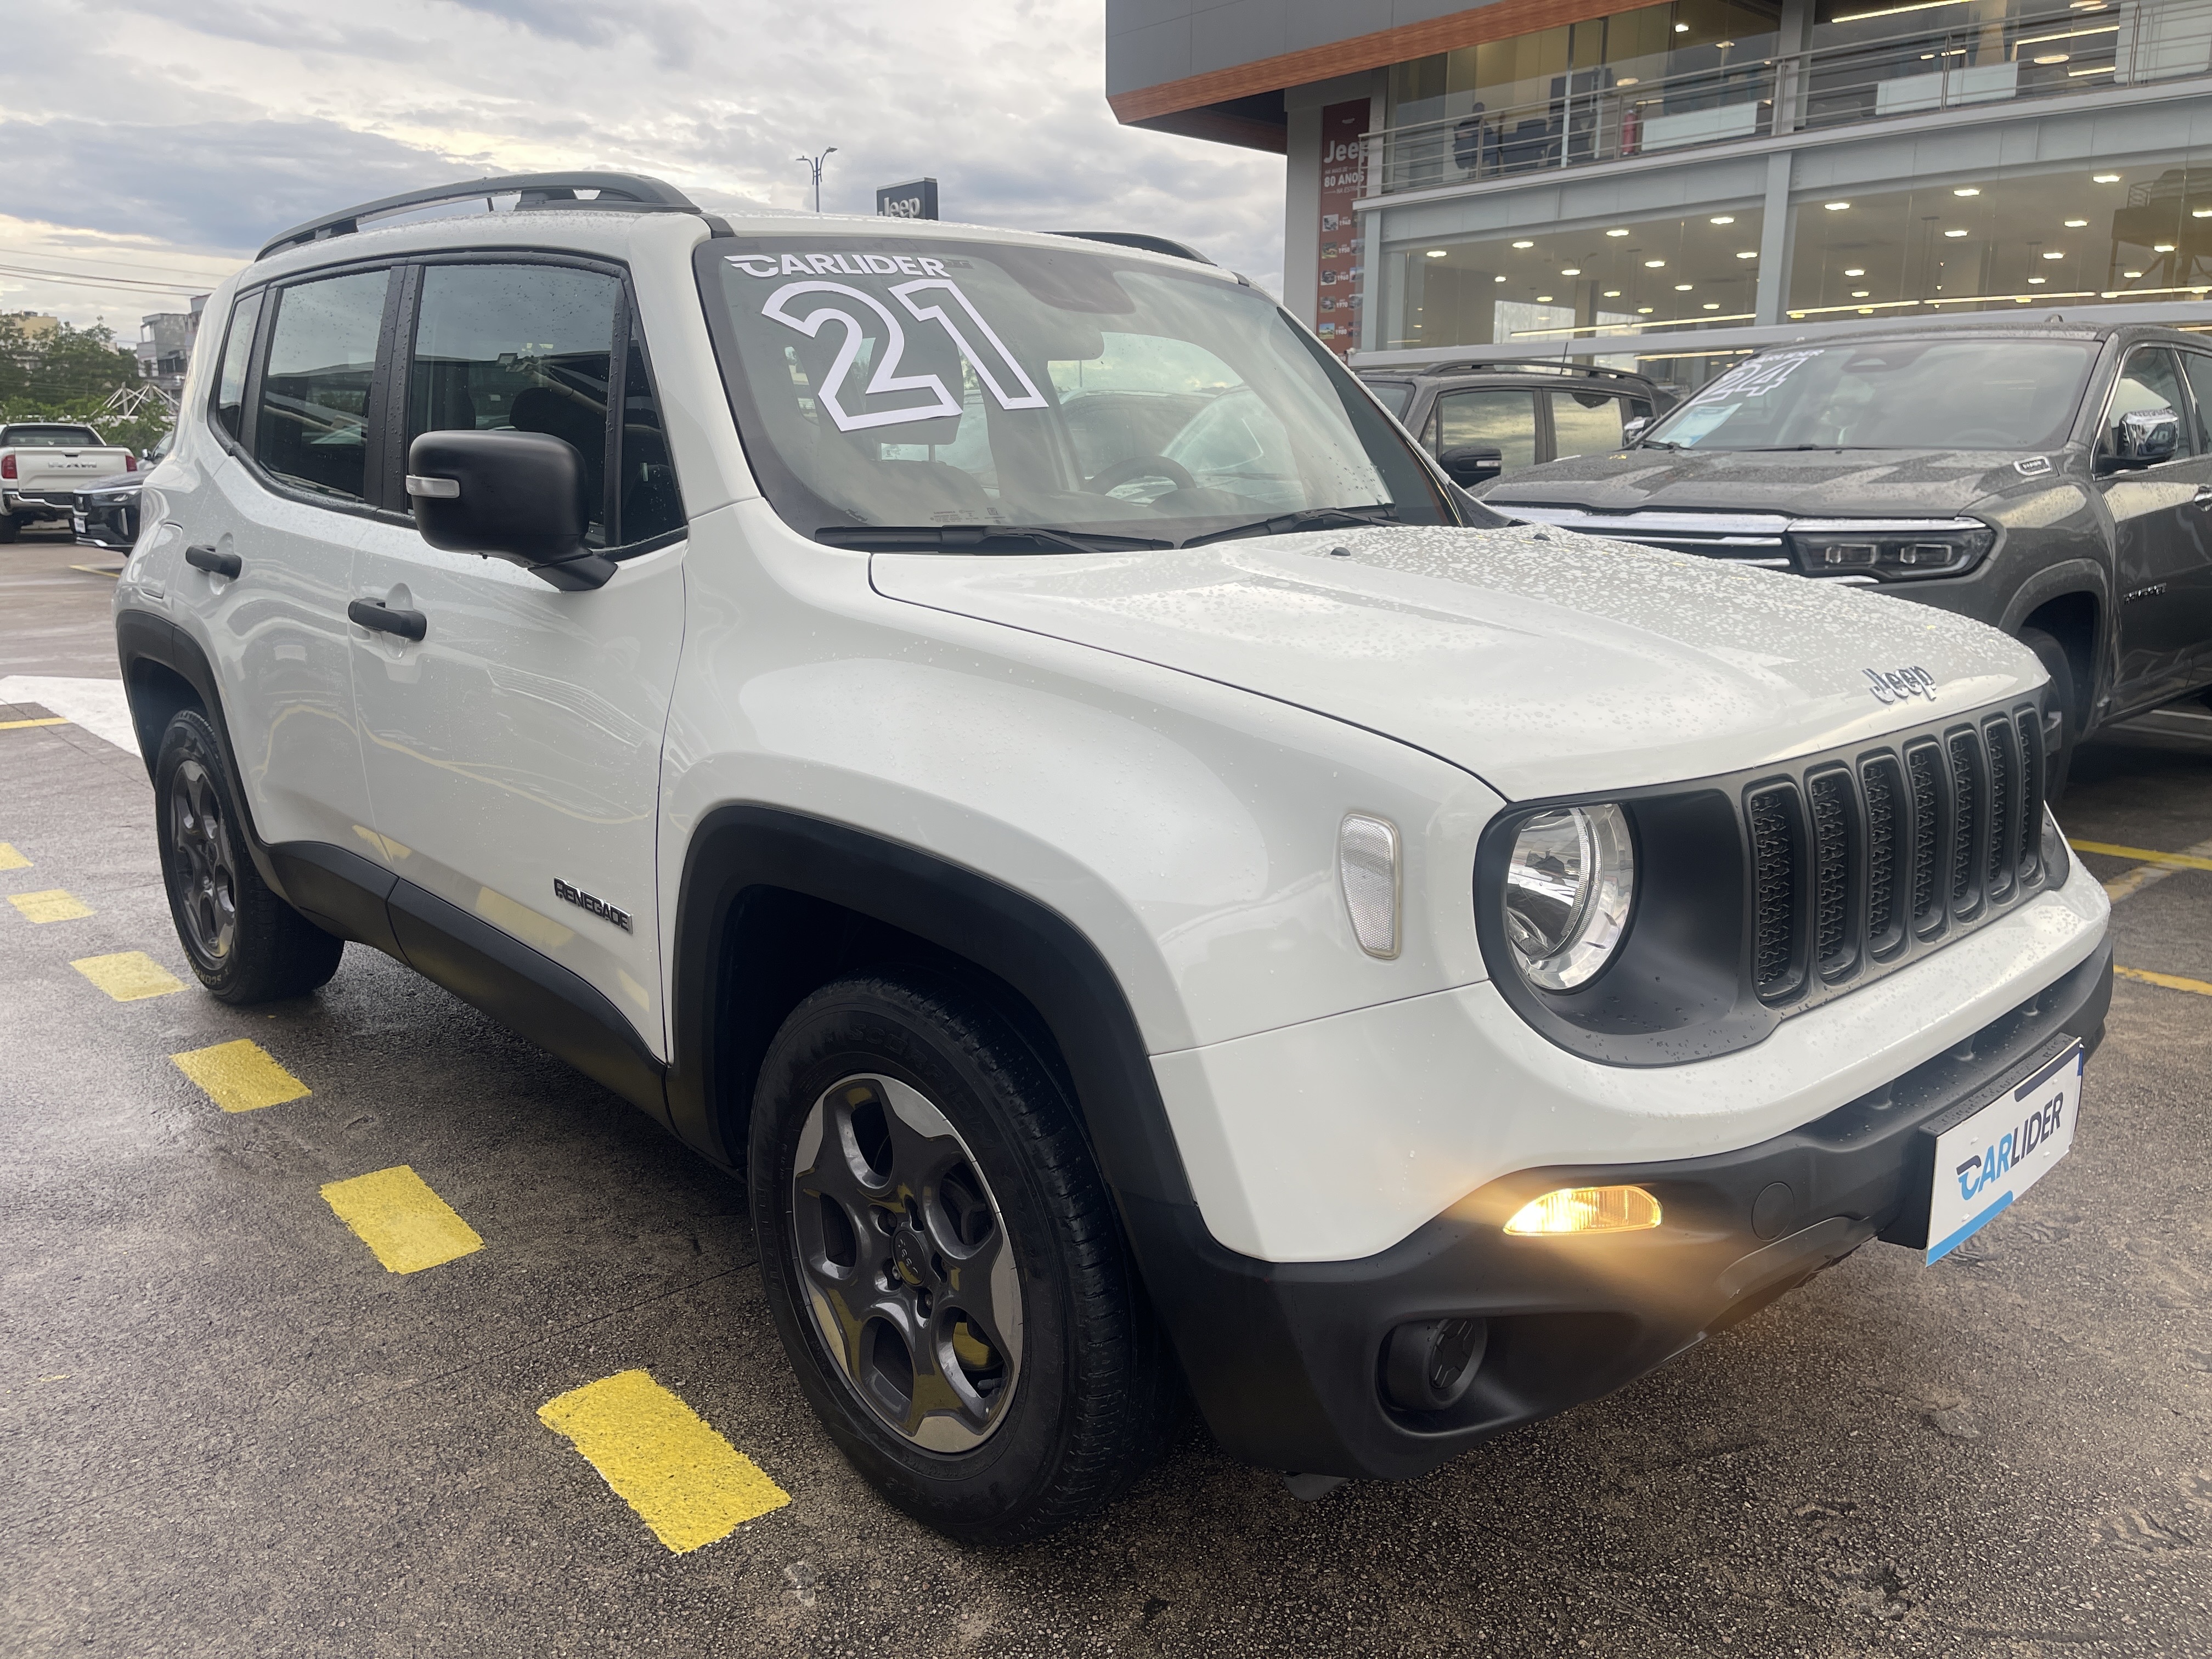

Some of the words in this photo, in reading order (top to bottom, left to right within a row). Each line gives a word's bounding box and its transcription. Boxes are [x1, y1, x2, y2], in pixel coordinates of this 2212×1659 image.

[1324, 140, 1369, 163] Jeep
[1324, 176, 1336, 187] 80
[1338, 171, 1364, 185] ANOS
[878, 197, 920, 218] Jeep
[724, 254, 952, 277] CARLIDER
[761, 279, 1049, 432] 21
[1686, 357, 1809, 406] 24
[1861, 665, 1937, 706] Jeep
[554, 876, 634, 935] RENEGADE
[1956, 1091, 2063, 1200] CARLIDER
